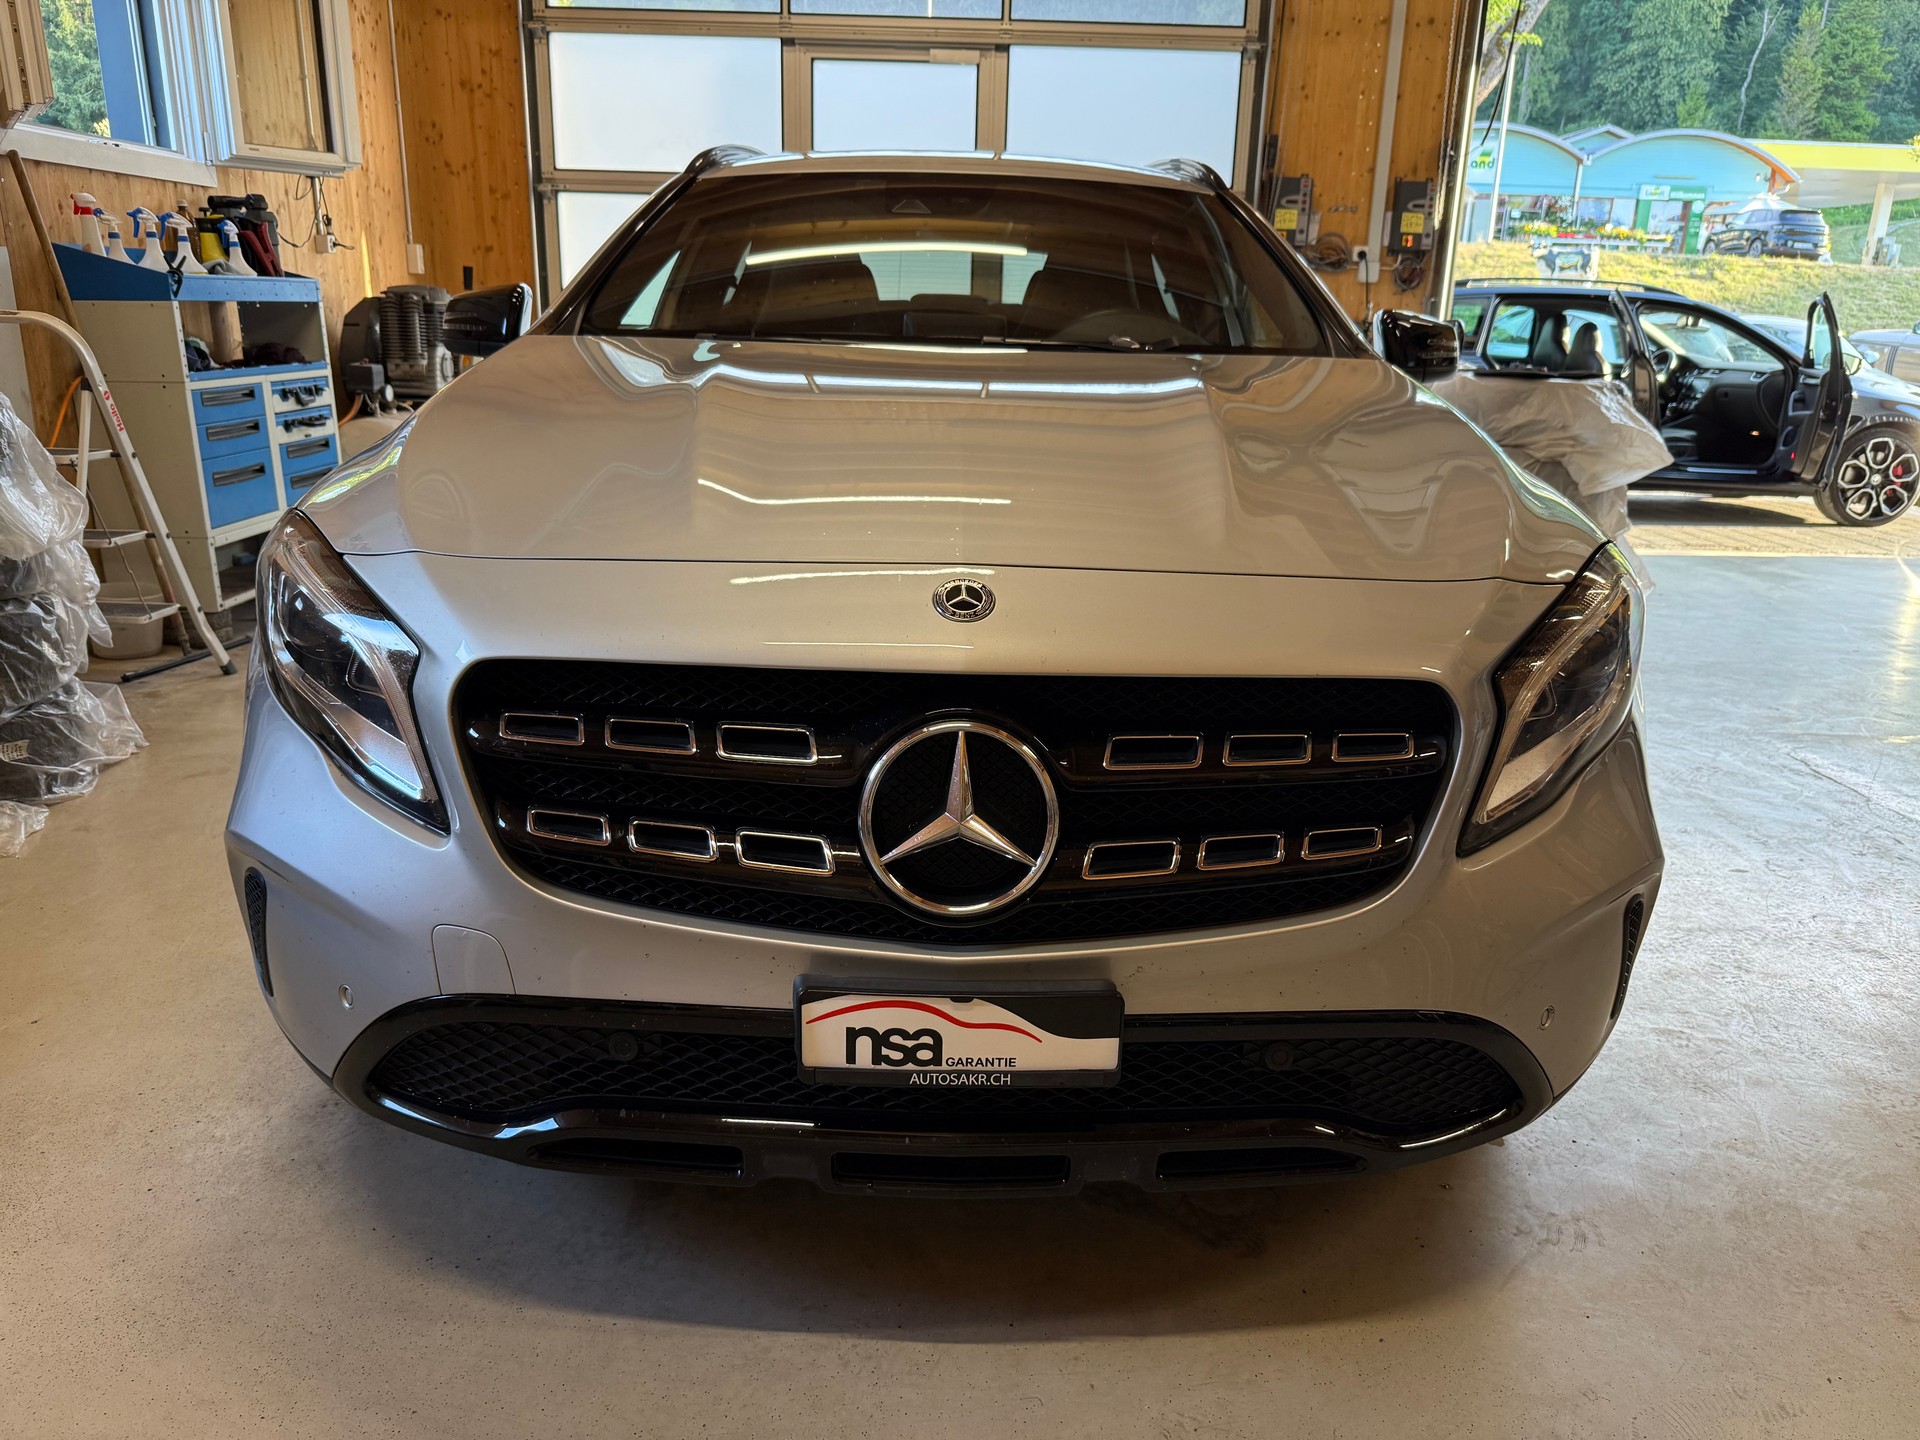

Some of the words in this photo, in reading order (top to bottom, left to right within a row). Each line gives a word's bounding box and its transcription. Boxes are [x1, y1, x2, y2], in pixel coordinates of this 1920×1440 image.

[1470, 157, 1496, 169] and
[110, 403, 125, 432] Hailo
[845, 1026, 943, 1067] nsa
[945, 1057, 1017, 1068] GARANTIE
[909, 1072, 1012, 1086] AUTOSAKR.CH
